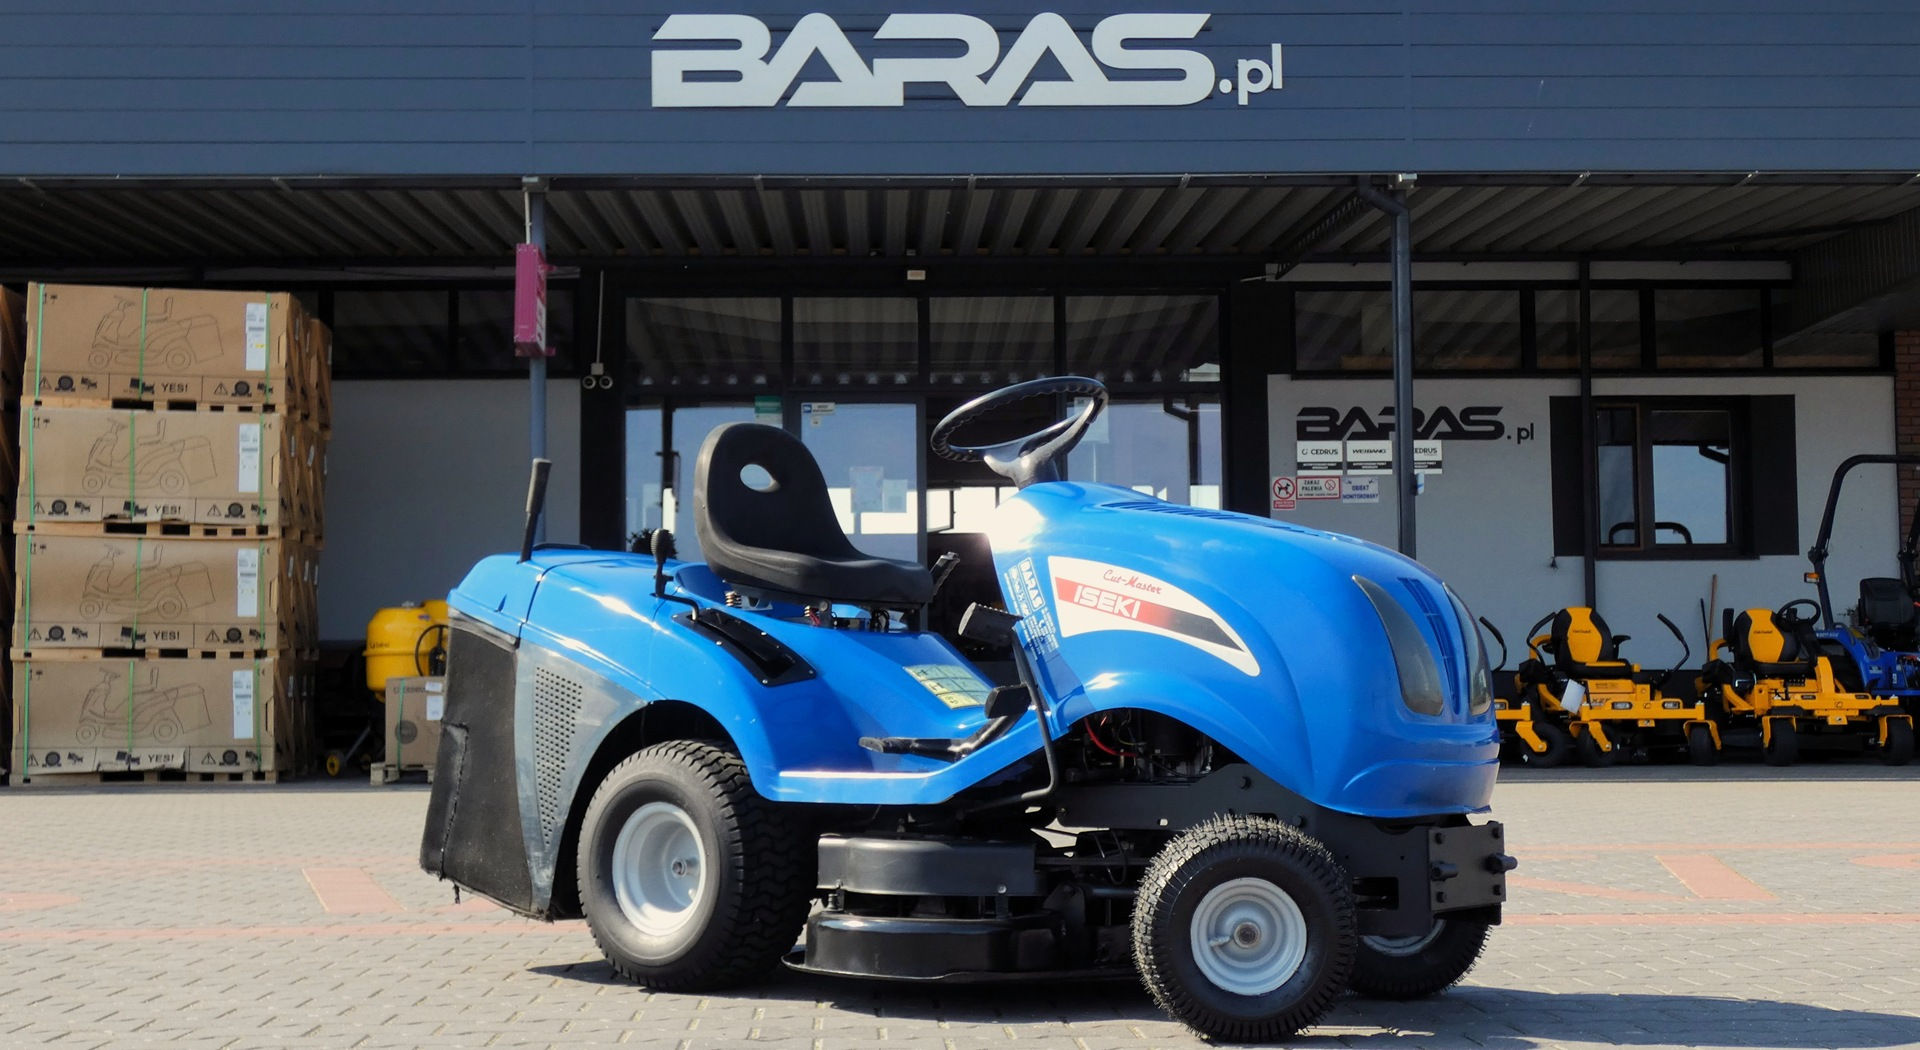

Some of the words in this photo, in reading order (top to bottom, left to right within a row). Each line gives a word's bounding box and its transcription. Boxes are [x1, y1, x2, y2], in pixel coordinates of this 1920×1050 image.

[161, 383, 189, 393] YES!
[154, 505, 181, 515] YES!
[1103, 569, 1163, 595] Cut-Master
[1073, 585, 1142, 619] ISEKI
[153, 630, 180, 641] YES!
[147, 754, 175, 764] YES!
